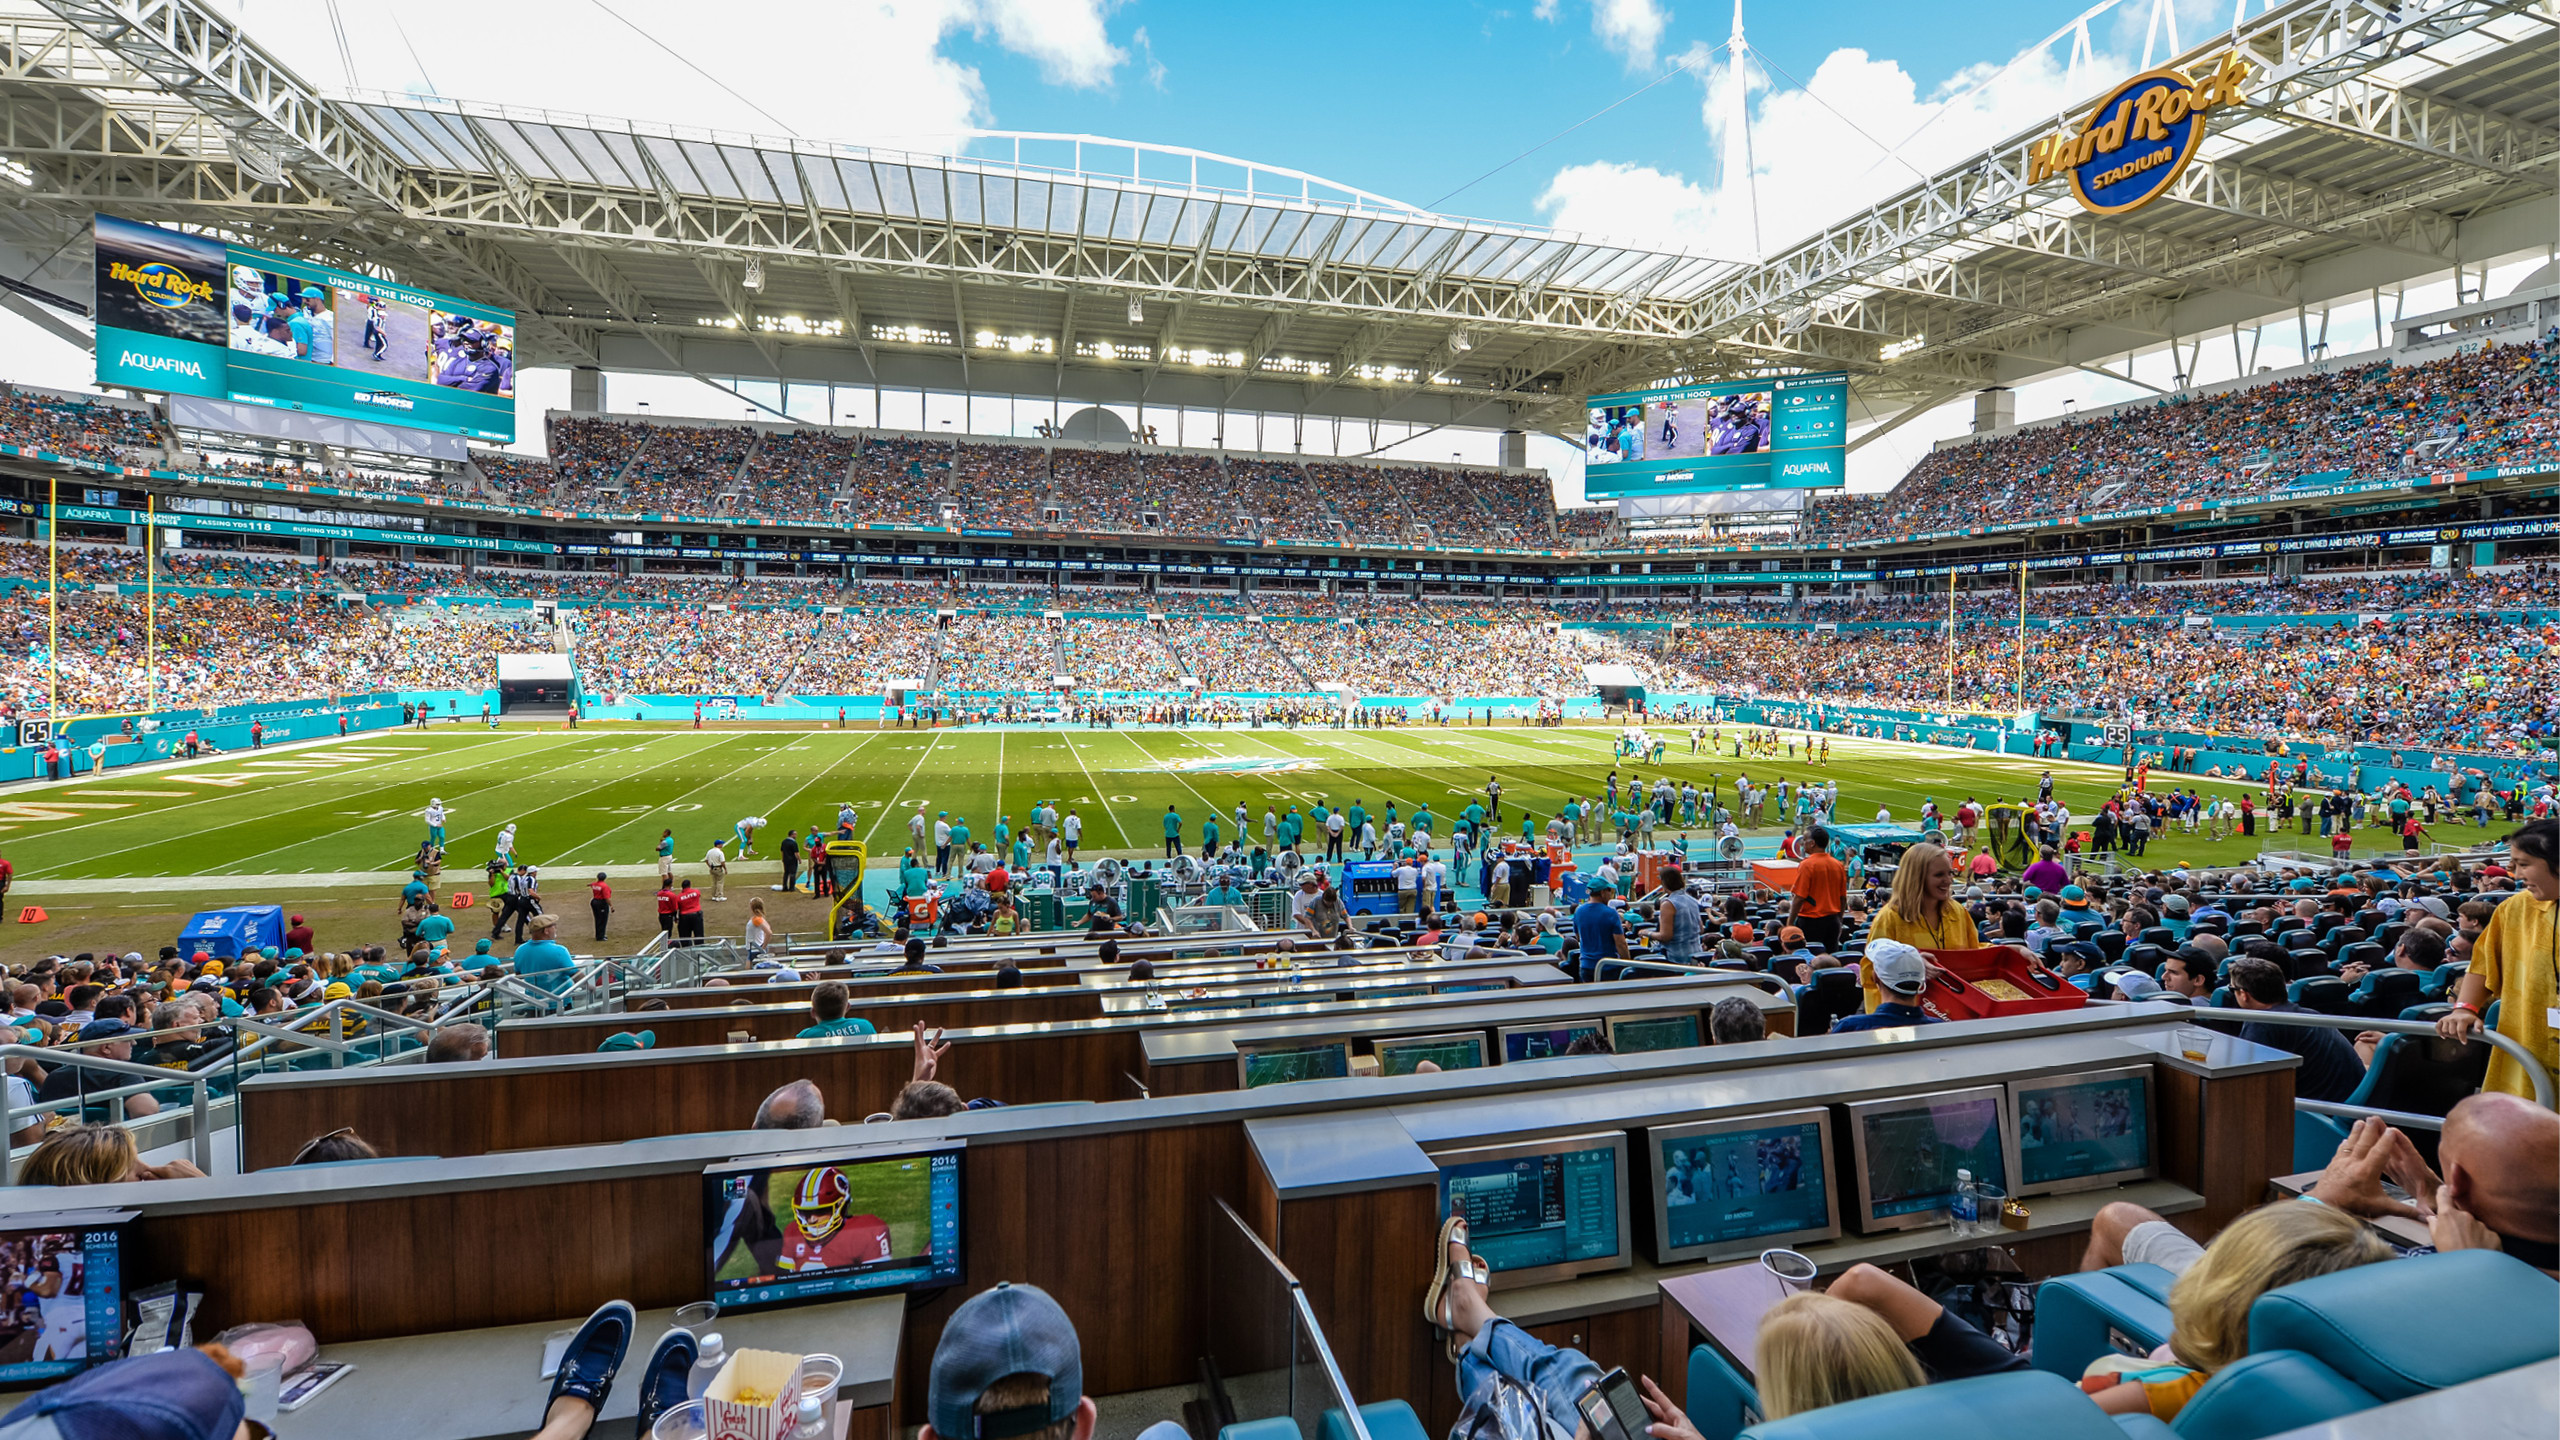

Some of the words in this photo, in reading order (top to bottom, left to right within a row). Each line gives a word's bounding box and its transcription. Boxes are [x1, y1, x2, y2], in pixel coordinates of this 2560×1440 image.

[2027, 99, 2132, 185] Hard
[2131, 51, 2250, 141] Rock
[2093, 146, 2173, 190] STADIUM
[110, 262, 165, 288] Hard
[165, 274, 214, 301] Rock
[328, 276, 371, 294] UNDER
[374, 287, 397, 300] THE
[400, 293, 434, 308] HOOD
[120, 350, 206, 380] AQUAFINA
[354, 392, 370, 404] ED
[1642, 394, 1668, 402] UNDER
[1687, 390, 1711, 398] HOOD
[1782, 461, 1832, 477] AQUAFINA
[2497, 466, 2537, 477] MARK
[178, 473, 199, 482] DICK
[203, 476, 248, 487] ANDERSON
[250, 480, 263, 488] 40
[355, 491, 383, 500] MOORE
[2269, 493, 2289, 501] DAN
[2291, 490, 2330, 499] MARINO
[2332, 487, 2344, 495] 13
[460, 500, 483, 510] LARRY
[486, 504, 515, 513] CSONKA
[2355, 505, 2379, 513] MVP
[2381, 502, 2412, 511] CLUB
[65, 508, 113, 521] AQUAFINA
[2092, 512, 2113, 520] MARK
[2115, 507, 2148, 518] CLAYTON
[2150, 507, 2161, 515] 83
[197, 519, 231, 527] PASSING
[249, 522, 272, 531] 118
[2462, 527, 2491, 538] FAMILY
[2493, 525, 2523, 536] OWNED
[2524, 524, 2542, 534] AND
[293, 526, 325, 534] RUSHING
[341, 529, 354, 537] 31
[2403, 530, 2438, 538] MORSE
[416, 535, 436, 543] 149
[468, 539, 494, 547] 11:38
[2281, 541, 2304, 550] FAMILY
[2304, 539, 2328, 549] OWNED
[2329, 538, 2343, 547] AND
[25, 723, 48, 742] 25
[2108, 728, 2128, 742] 25
[1391, 829, 1402, 839] 52
[1958, 854, 1966, 866] G
[1036, 872, 1051, 884] 98
[1071, 875, 1085, 887] 97
[454, 894, 469, 907] 20
[681, 892, 697, 901] ELITE
[23, 907, 37, 922] 10
[914, 904, 928, 918] G
[825, 1024, 861, 1038] PARKER
[931, 1156, 957, 1166] 2016
[85, 1231, 118, 1243] 2016
